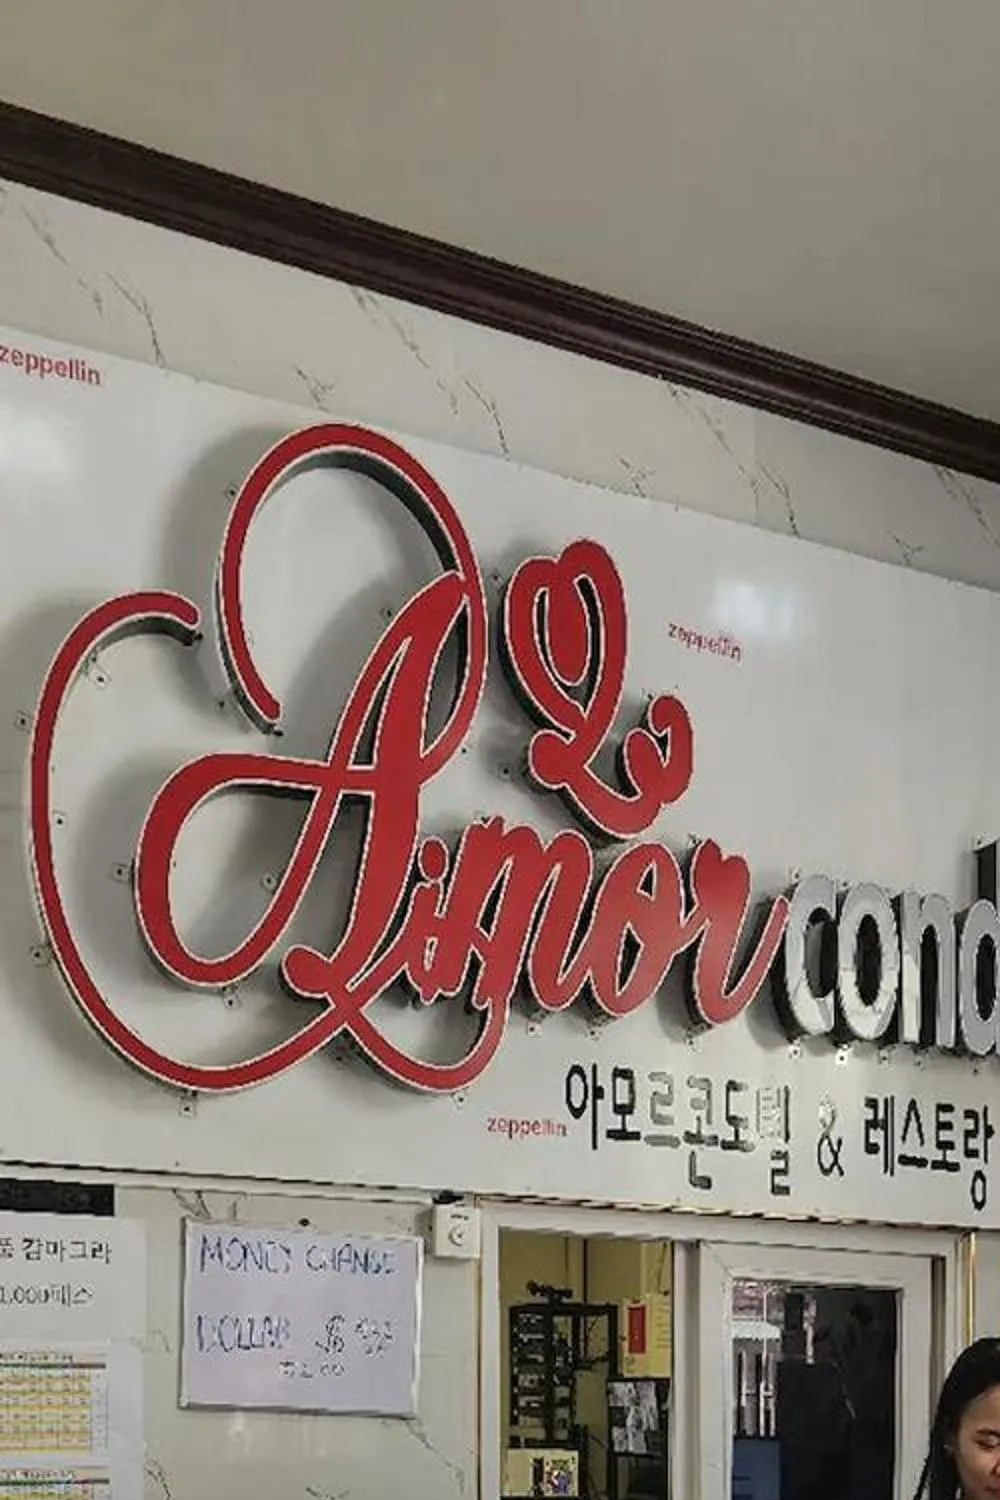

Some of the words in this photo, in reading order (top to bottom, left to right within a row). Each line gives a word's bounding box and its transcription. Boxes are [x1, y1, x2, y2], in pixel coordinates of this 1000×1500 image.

[565, 1062, 792, 1197] 아모르콘도텔
[817, 1094, 846, 1177] &
[864, 1095, 994, 1211] 레스토랑
[201, 1234, 291, 1274] MONEY
